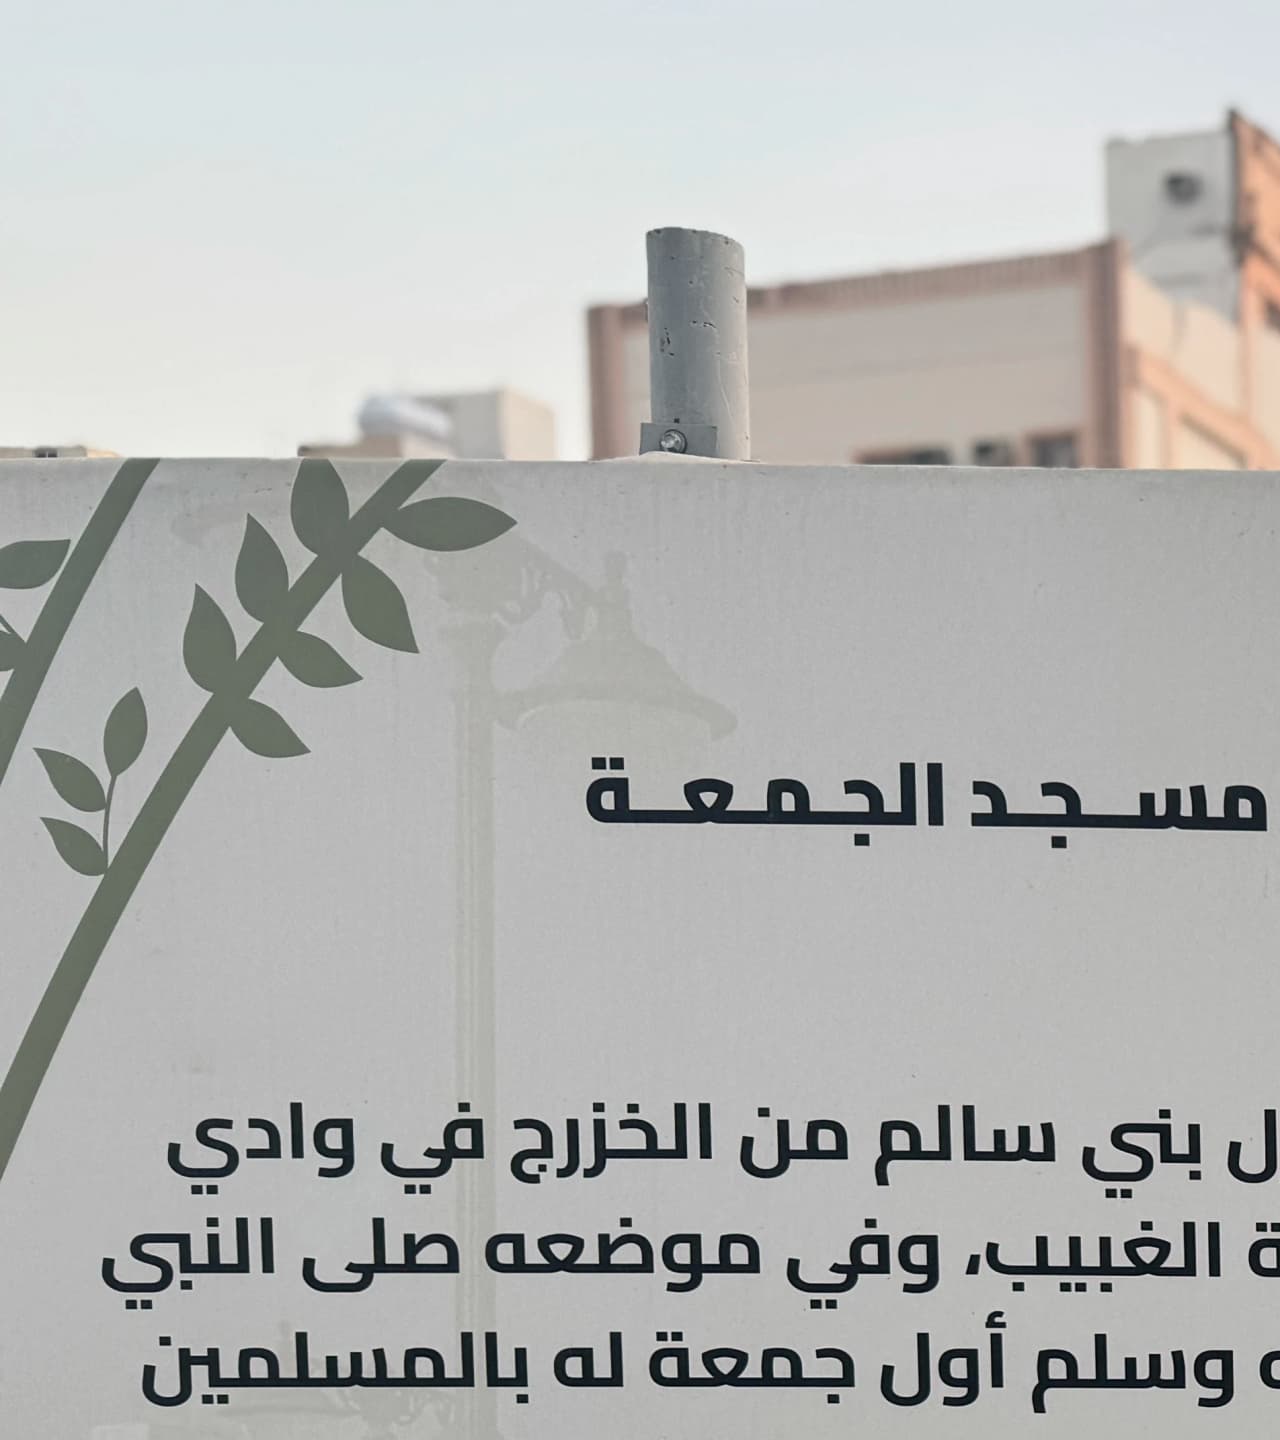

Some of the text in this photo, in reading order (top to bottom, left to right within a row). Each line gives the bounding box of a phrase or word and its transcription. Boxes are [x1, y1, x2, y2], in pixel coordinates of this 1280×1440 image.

[585, 756, 1268, 849] مسجد الجمعة
[167, 1102, 355, 1195] وادي
[380, 1102, 485, 1195] في
[510, 1102, 713, 1185] الخزرج
[739, 1107, 849, 1179] من
[874, 1104, 1056, 1187] سالم
[1081, 1108, 1202, 1199] بني
[101, 1217, 275, 1310] النبي
[302, 1217, 460, 1293] صلى
[484, 1217, 761, 1293] موضعه
[786, 1218, 940, 1310] وفي
[965, 1220, 1221, 1293] الغبيب،
[142, 1331, 529, 1408] بالمسلمين
[553, 1331, 624, 1388] له
[648, 1331, 856, 1404] جمعة
[880, 1310, 1007, 1407] أول
[1031, 1333, 1234, 1414] وسلم
